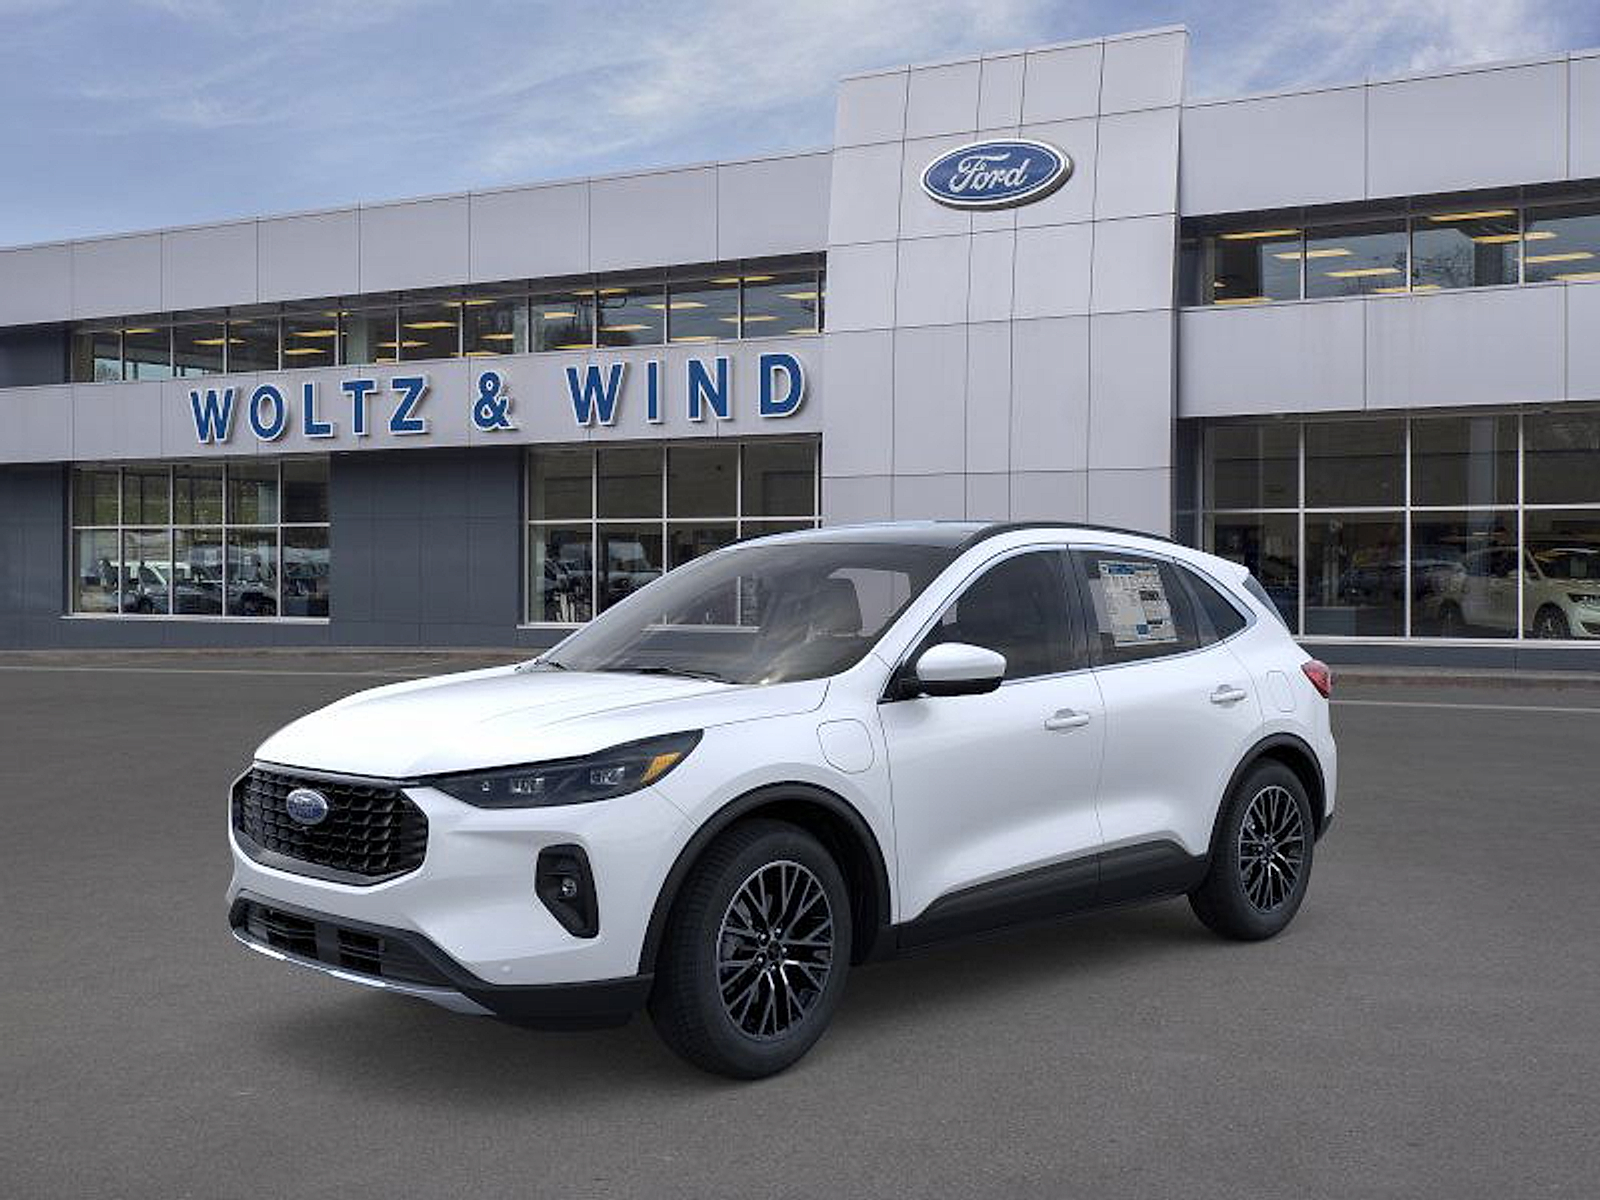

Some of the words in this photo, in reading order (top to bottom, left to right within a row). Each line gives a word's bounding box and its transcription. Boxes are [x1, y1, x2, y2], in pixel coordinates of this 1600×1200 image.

[949, 152, 1031, 193] Ford
[189, 376, 429, 444] WOLTZ
[472, 371, 514, 430] &
[565, 352, 806, 426] WIND
